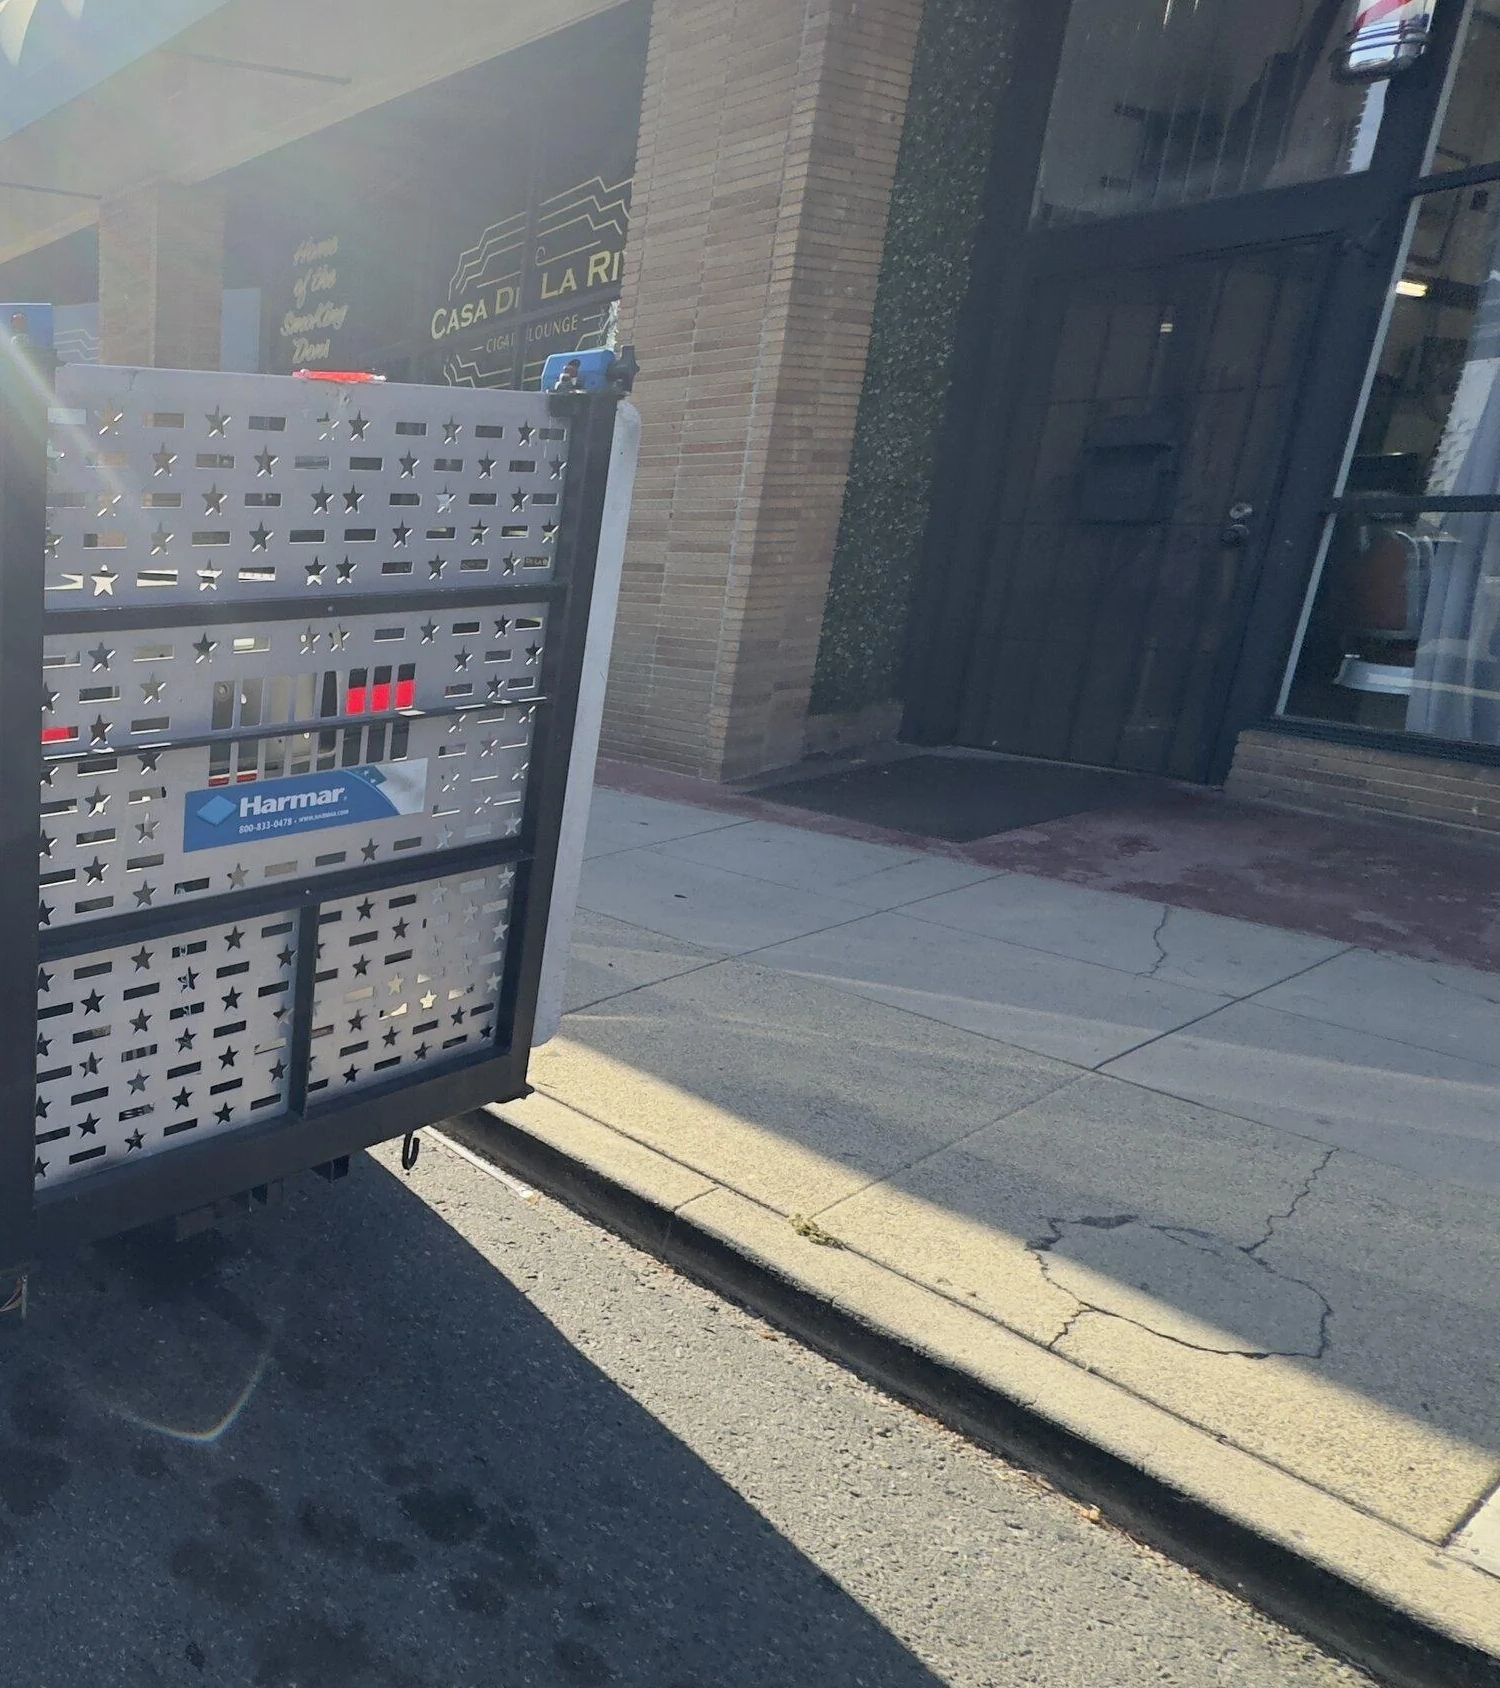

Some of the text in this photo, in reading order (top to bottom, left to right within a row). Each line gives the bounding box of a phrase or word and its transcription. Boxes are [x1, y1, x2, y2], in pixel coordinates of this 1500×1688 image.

[294, 268, 313, 308] of
[431, 299, 488, 340] CASA
[540, 268, 577, 300] LA
[587, 250, 621, 287] RI
[528, 314, 579, 342] LOUNGE
[240, 787, 345, 818] Harmar
[239, 817, 292, 834] 800-833-0478
